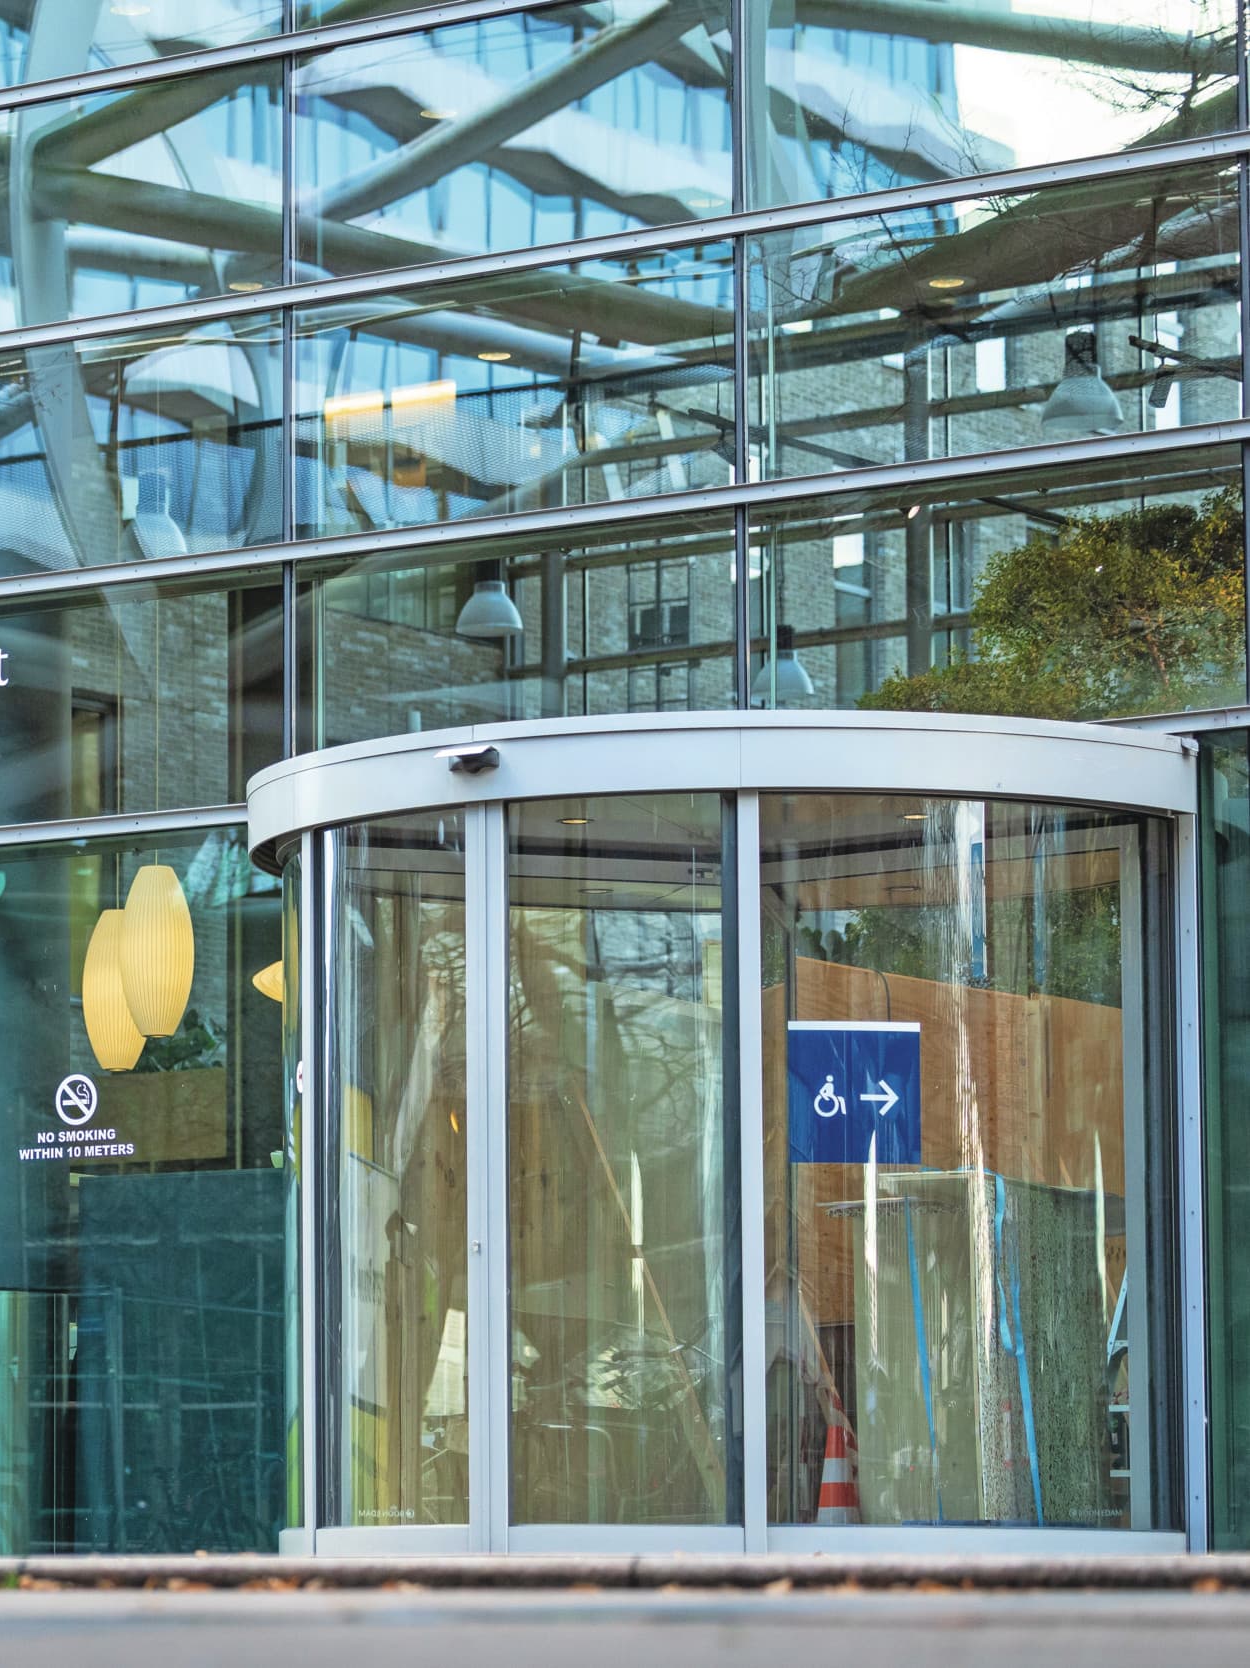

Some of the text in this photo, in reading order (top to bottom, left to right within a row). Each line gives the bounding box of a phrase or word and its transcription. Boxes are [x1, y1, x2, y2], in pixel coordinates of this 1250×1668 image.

[37, 1128, 116, 1144] NO SMOKING
[19, 1143, 135, 1160] WITHIN 10 METERS
